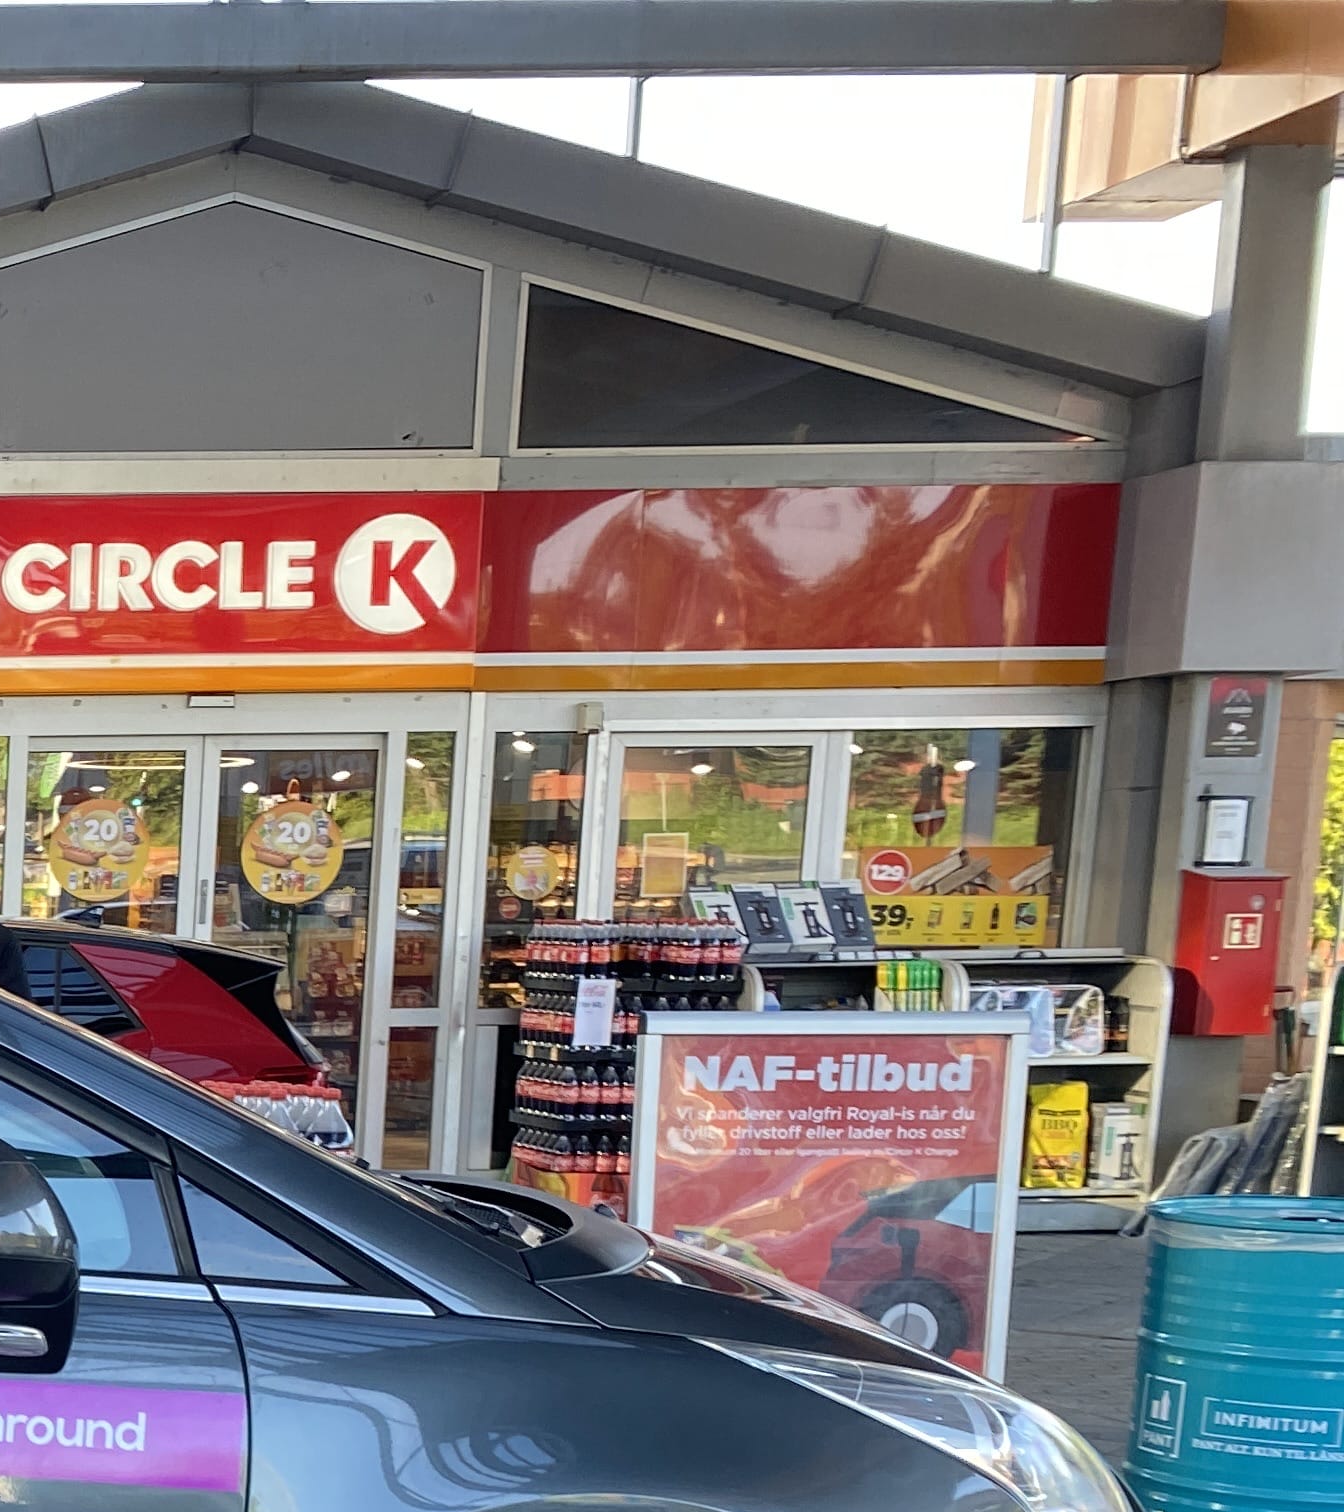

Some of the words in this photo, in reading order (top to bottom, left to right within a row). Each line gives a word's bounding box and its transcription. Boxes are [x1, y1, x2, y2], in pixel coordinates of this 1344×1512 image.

[1, 540, 316, 614] CIRCLE
[83, 818, 119, 842] 20
[275, 820, 313, 845] 20
[683, 1054, 974, 1092] NAF-tilbud
[676, 1106, 694, 1121] Vi
[698, 1106, 782, 1122] spanderer
[788, 1106, 843, 1123] valgfri
[846, 1106, 915, 1123] Royal-is
[919, 1105, 949, 1121] når
[952, 1106, 976, 1121] du
[1041, 1118, 1078, 1133] BBQ
[730, 1125, 802, 1140] drivstoff
[806, 1125, 845, 1140] eller
[848, 1125, 893, 1140] lader
[896, 1125, 927, 1140] hos
[931, 1125, 967, 1140] oss!
[1214, 1411, 1329, 1435] INFINITUM
[1143, 1429, 1175, 1449] PANT
